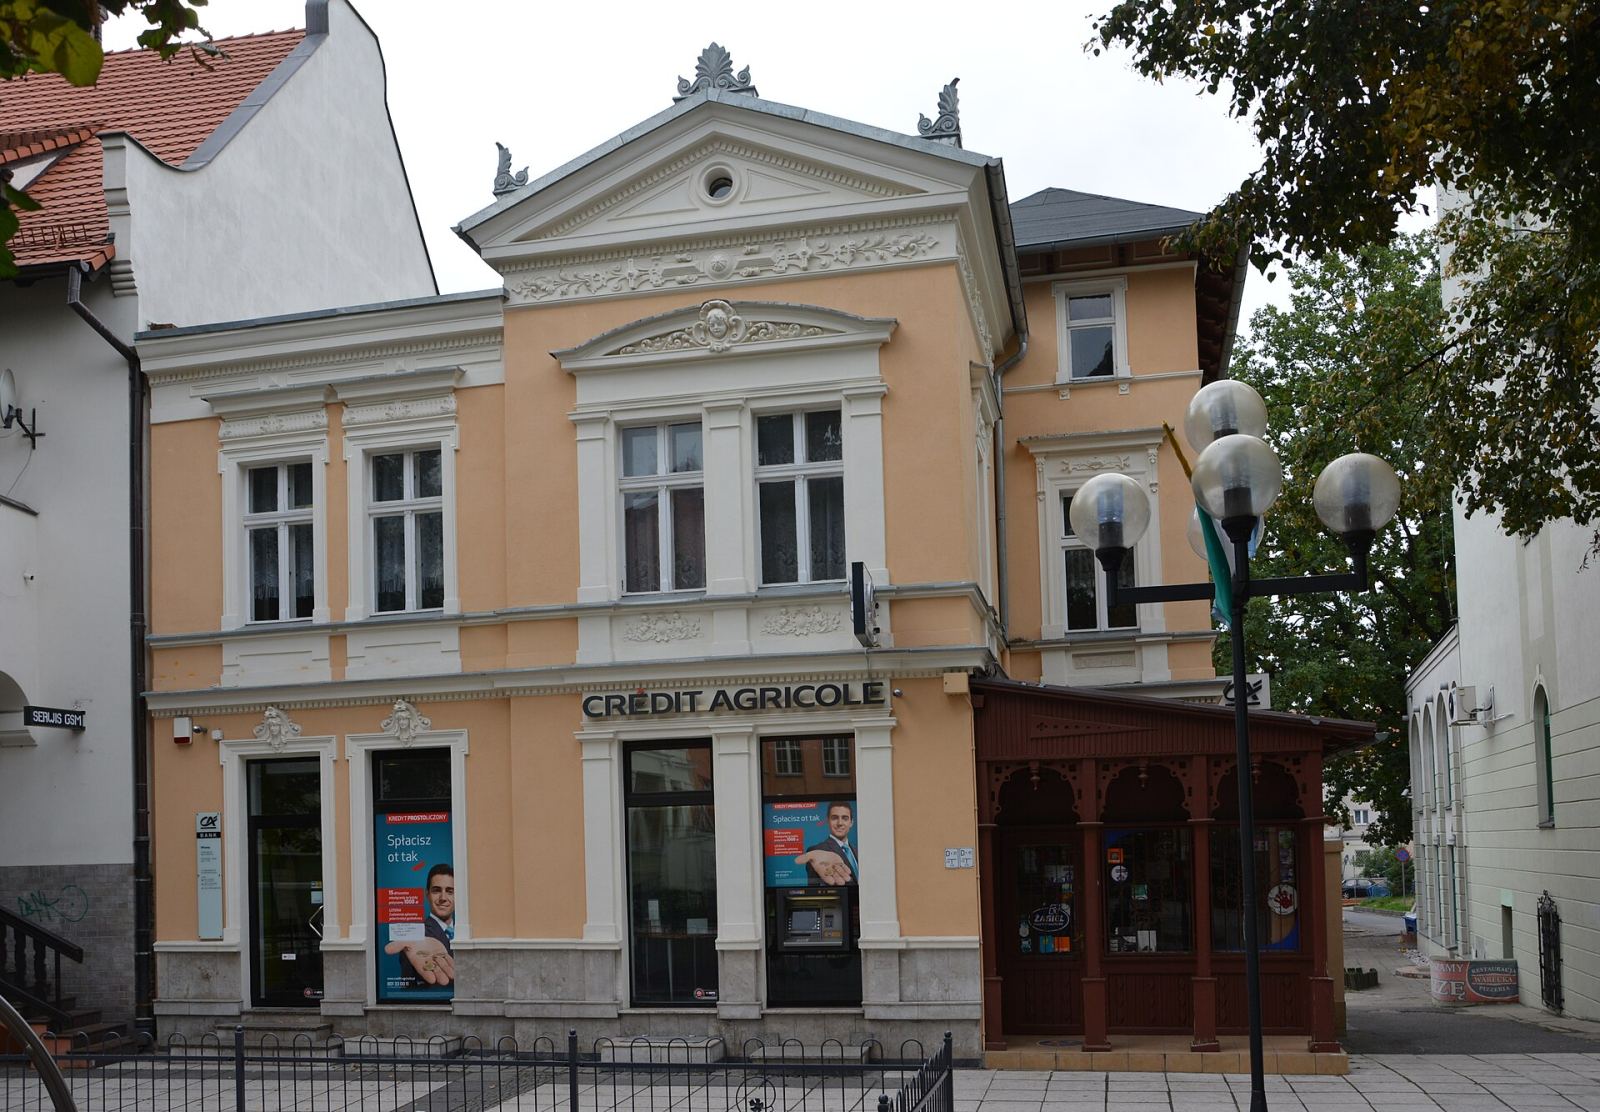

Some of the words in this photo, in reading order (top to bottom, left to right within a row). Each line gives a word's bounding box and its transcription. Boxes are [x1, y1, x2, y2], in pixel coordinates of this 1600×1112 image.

[582, 688, 703, 717] CRÉDIT
[709, 682, 885, 712] AGRICOLE
[64, 713, 82, 726] GSM
[773, 815, 800, 824] Spłacisz
[387, 834, 431, 849] Spłacisz
[387, 852, 399, 862] ot
[401, 850, 418, 862] tak
